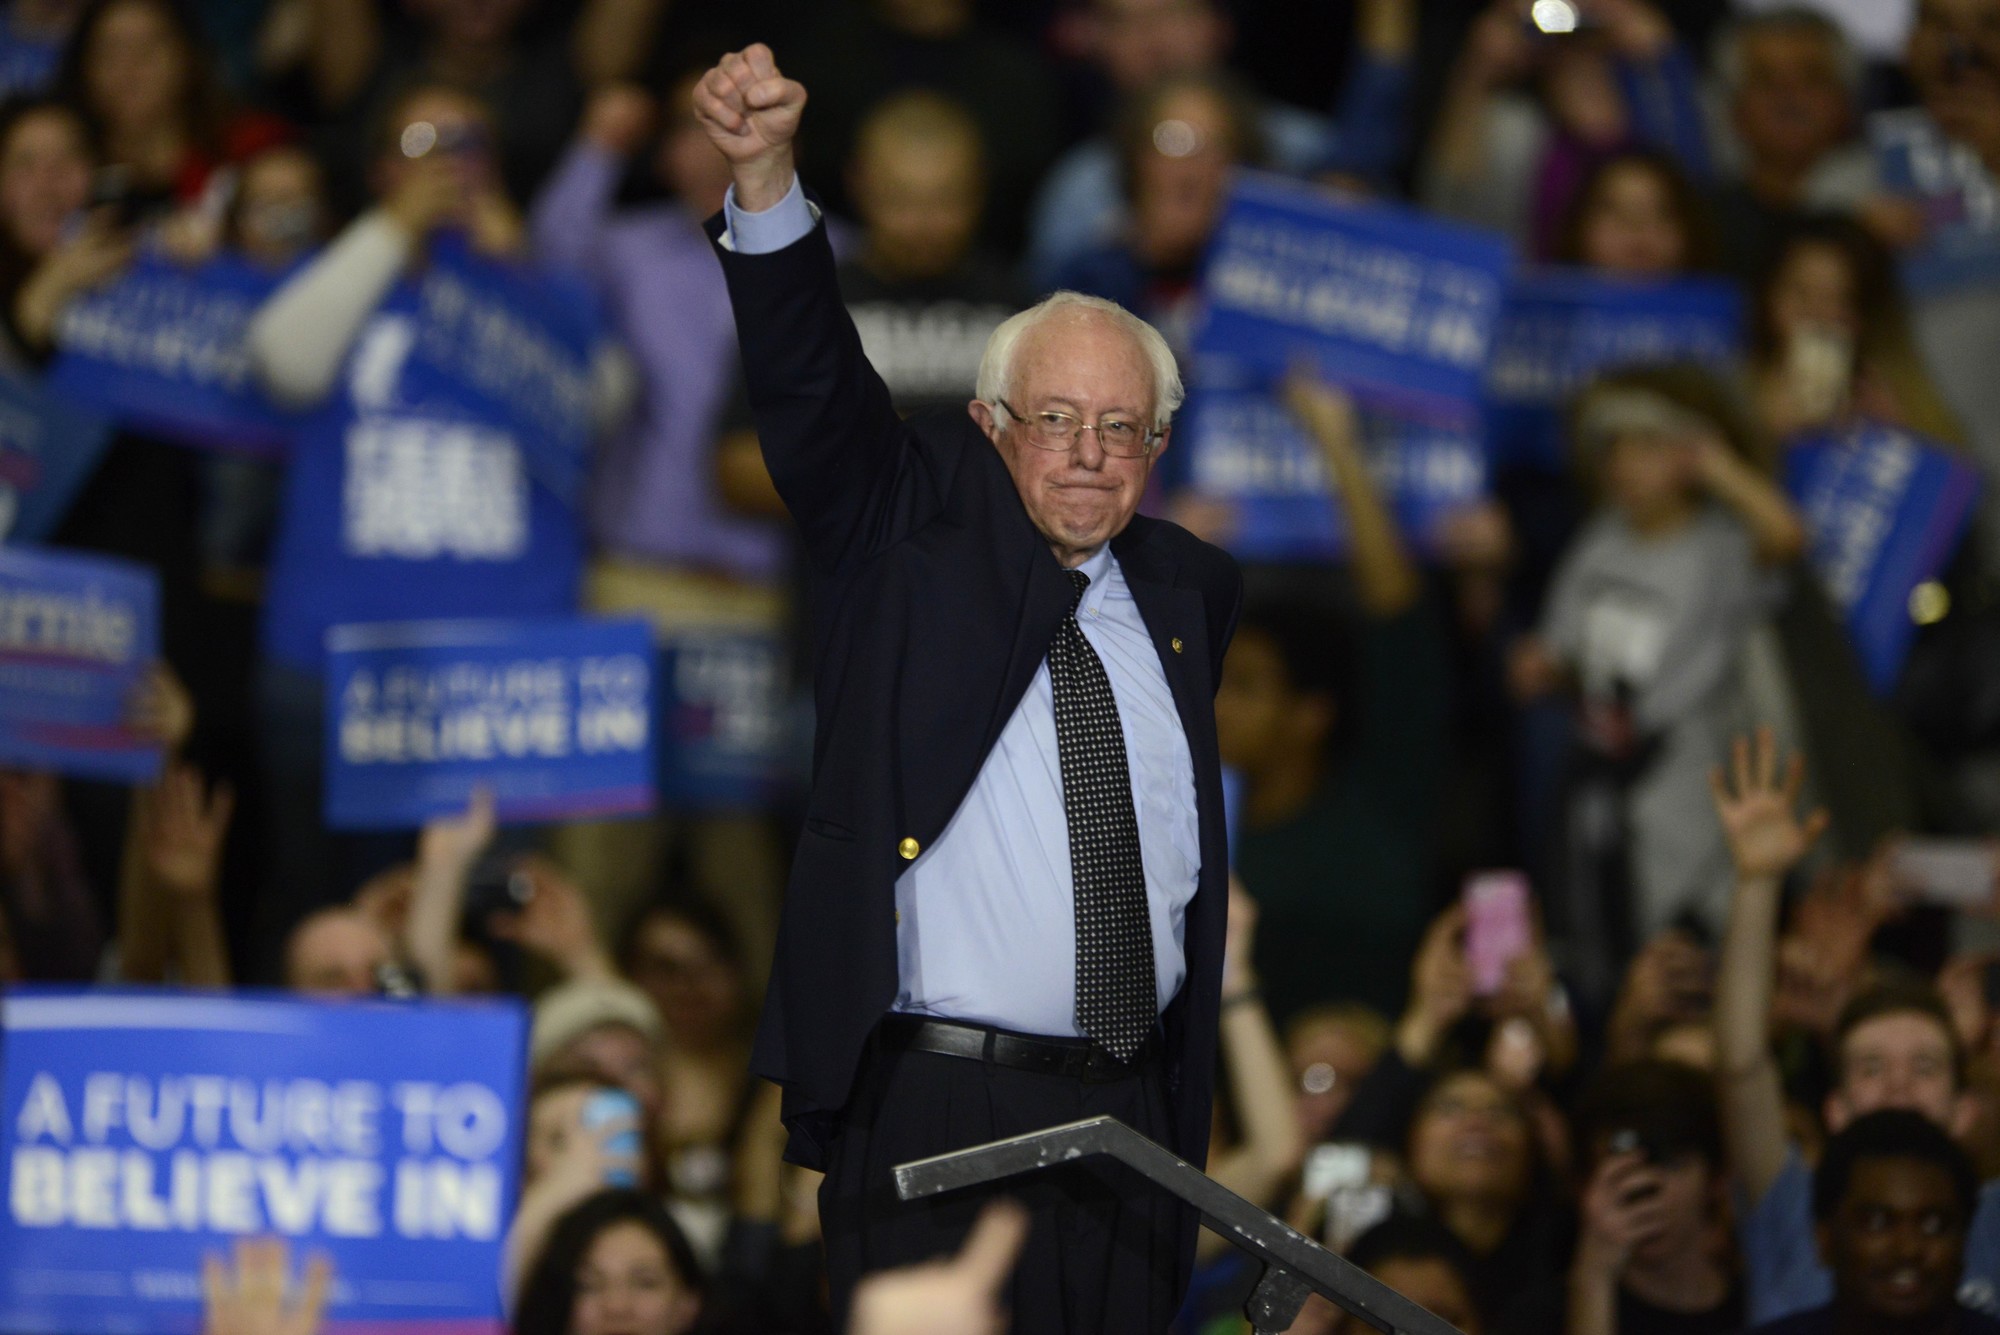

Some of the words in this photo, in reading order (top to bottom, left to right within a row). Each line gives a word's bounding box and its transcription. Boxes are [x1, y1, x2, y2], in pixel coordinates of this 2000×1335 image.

[382, 658, 566, 712] FUTURE
[577, 654, 648, 702] TO
[340, 706, 570, 764] BELIEVE
[576, 699, 648, 755] IN
[16, 1071, 74, 1146] A
[82, 1071, 384, 1158] FUTURE
[391, 1080, 507, 1160] TO
[8, 1145, 385, 1239] BELIEVE
[392, 1156, 502, 1241] IN
